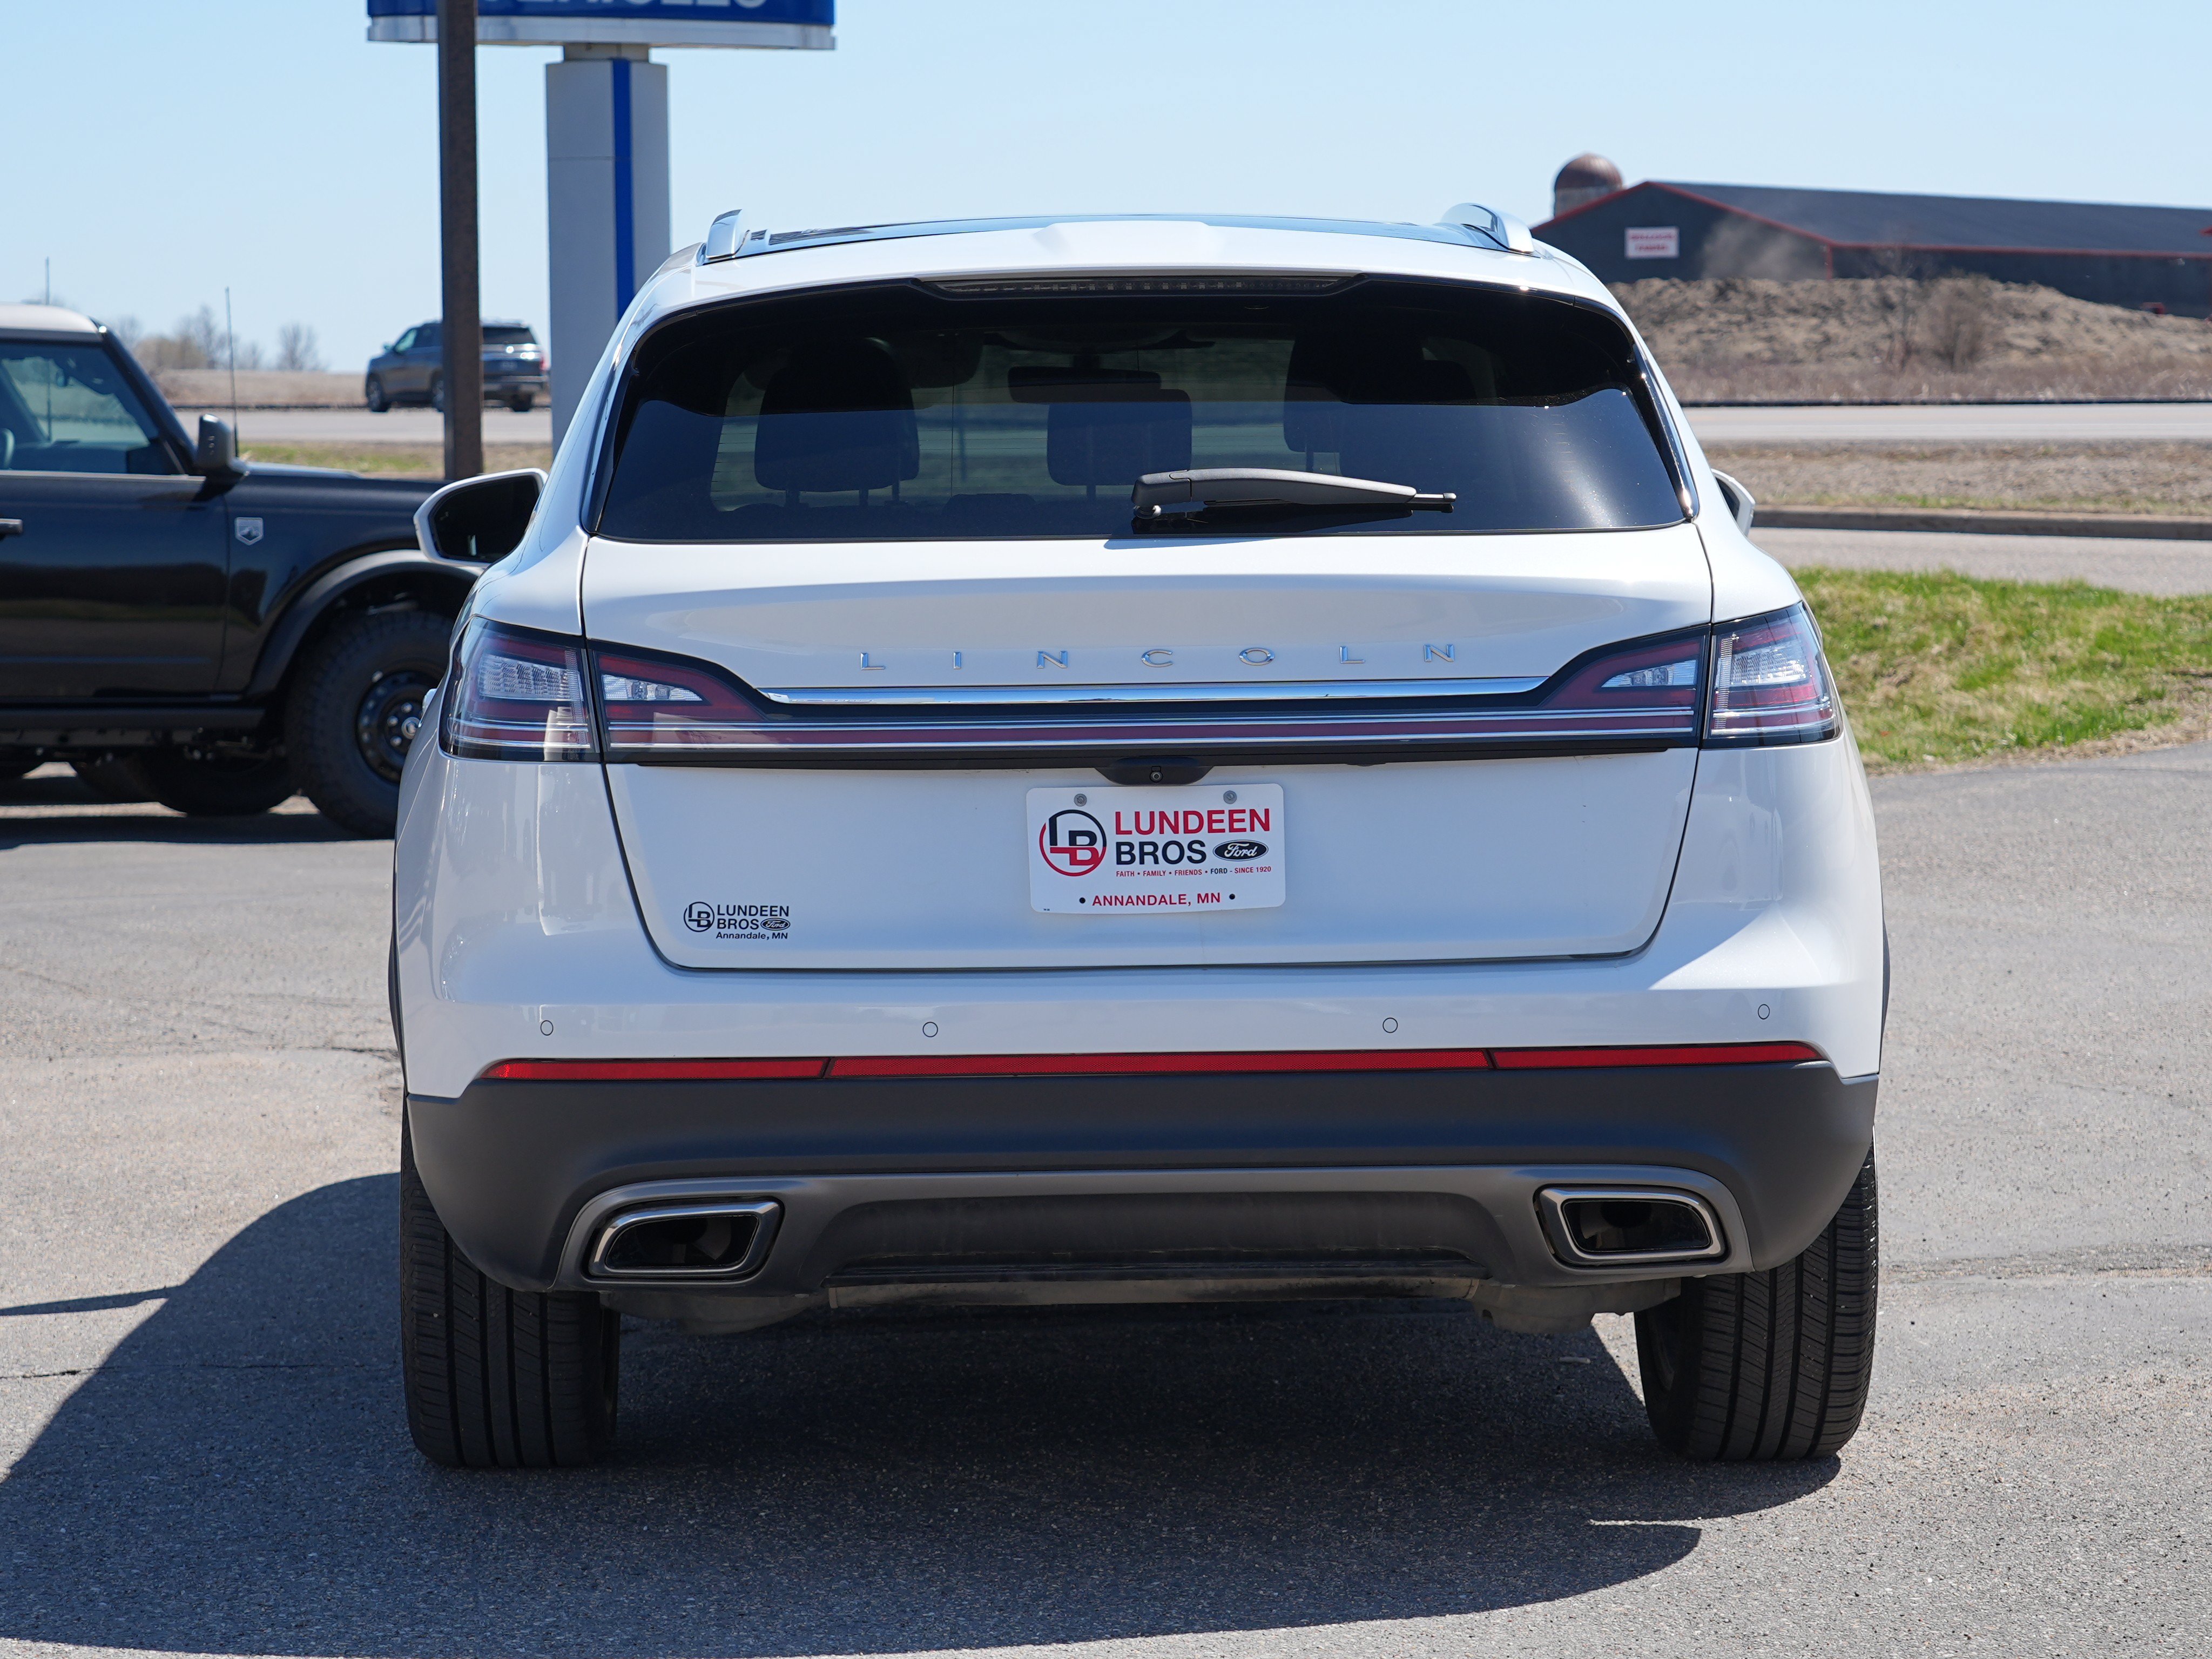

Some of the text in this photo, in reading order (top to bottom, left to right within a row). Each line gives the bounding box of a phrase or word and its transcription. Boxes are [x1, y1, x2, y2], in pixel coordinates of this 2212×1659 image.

[860, 644, 1454, 670] LINCOLN
[1115, 808, 1270, 835] LUNDEEN
[1115, 839, 1207, 865] BROS
[1092, 892, 1221, 906] ANNANDALE, MN
[717, 904, 790, 917] LUNDEEN
[717, 918, 759, 930] BROS
[716, 932, 770, 941] Annandale,
